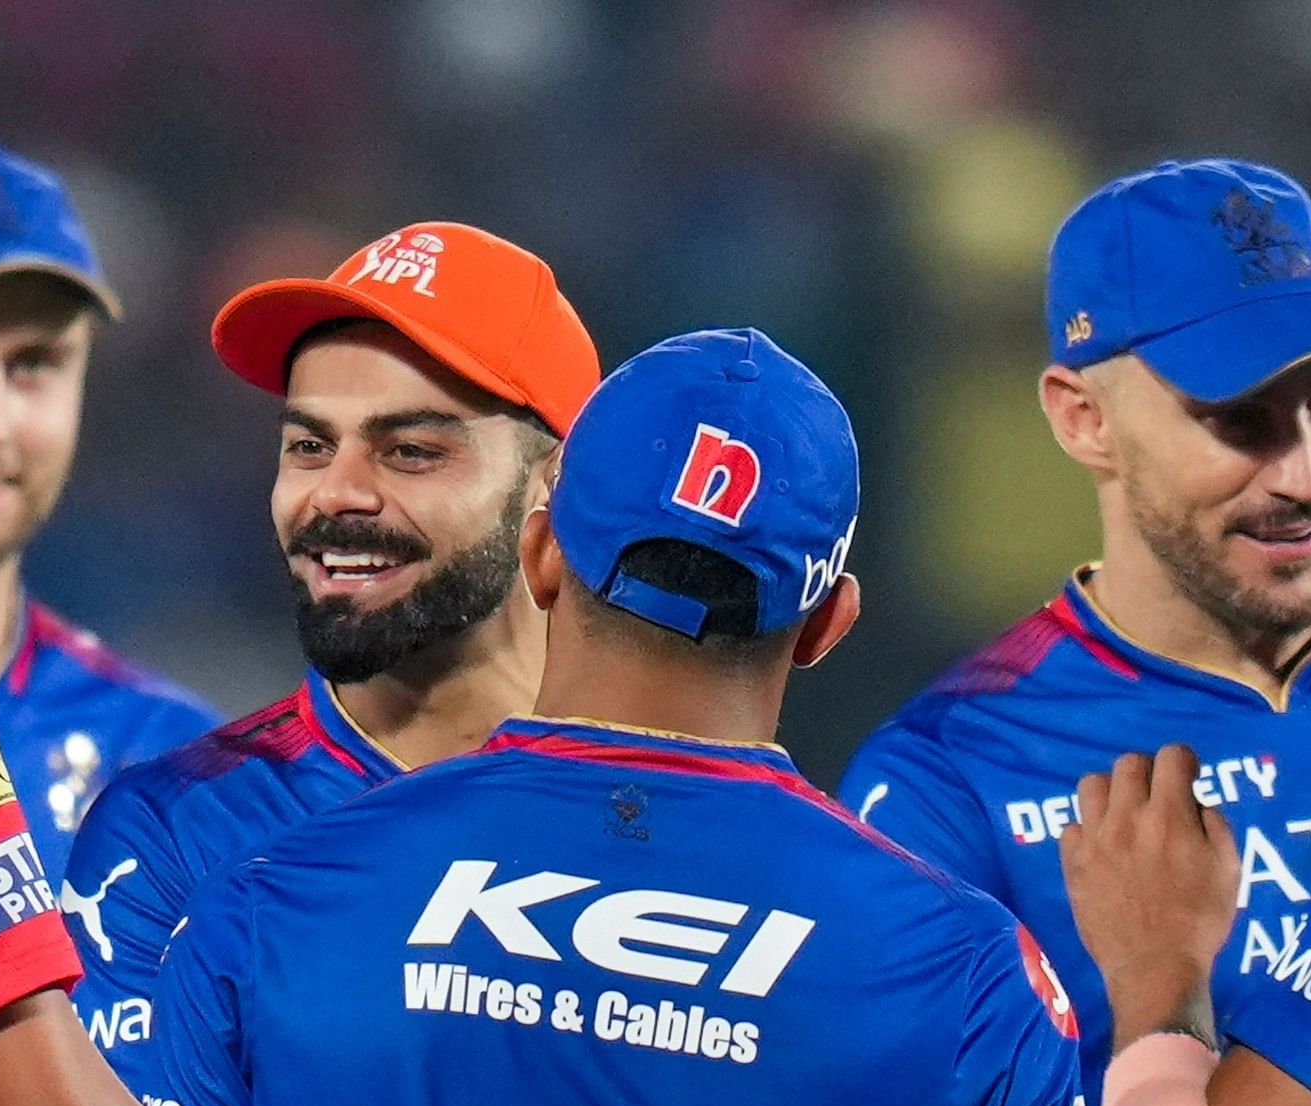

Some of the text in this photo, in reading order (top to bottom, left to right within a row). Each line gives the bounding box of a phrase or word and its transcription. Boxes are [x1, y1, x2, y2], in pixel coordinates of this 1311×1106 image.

[371, 257, 436, 298] IPL
[395, 248, 437, 270] TATA
[671, 422, 761, 528] n
[406, 858, 817, 998] KEI
[403, 961, 761, 1064] Wires & Cables
